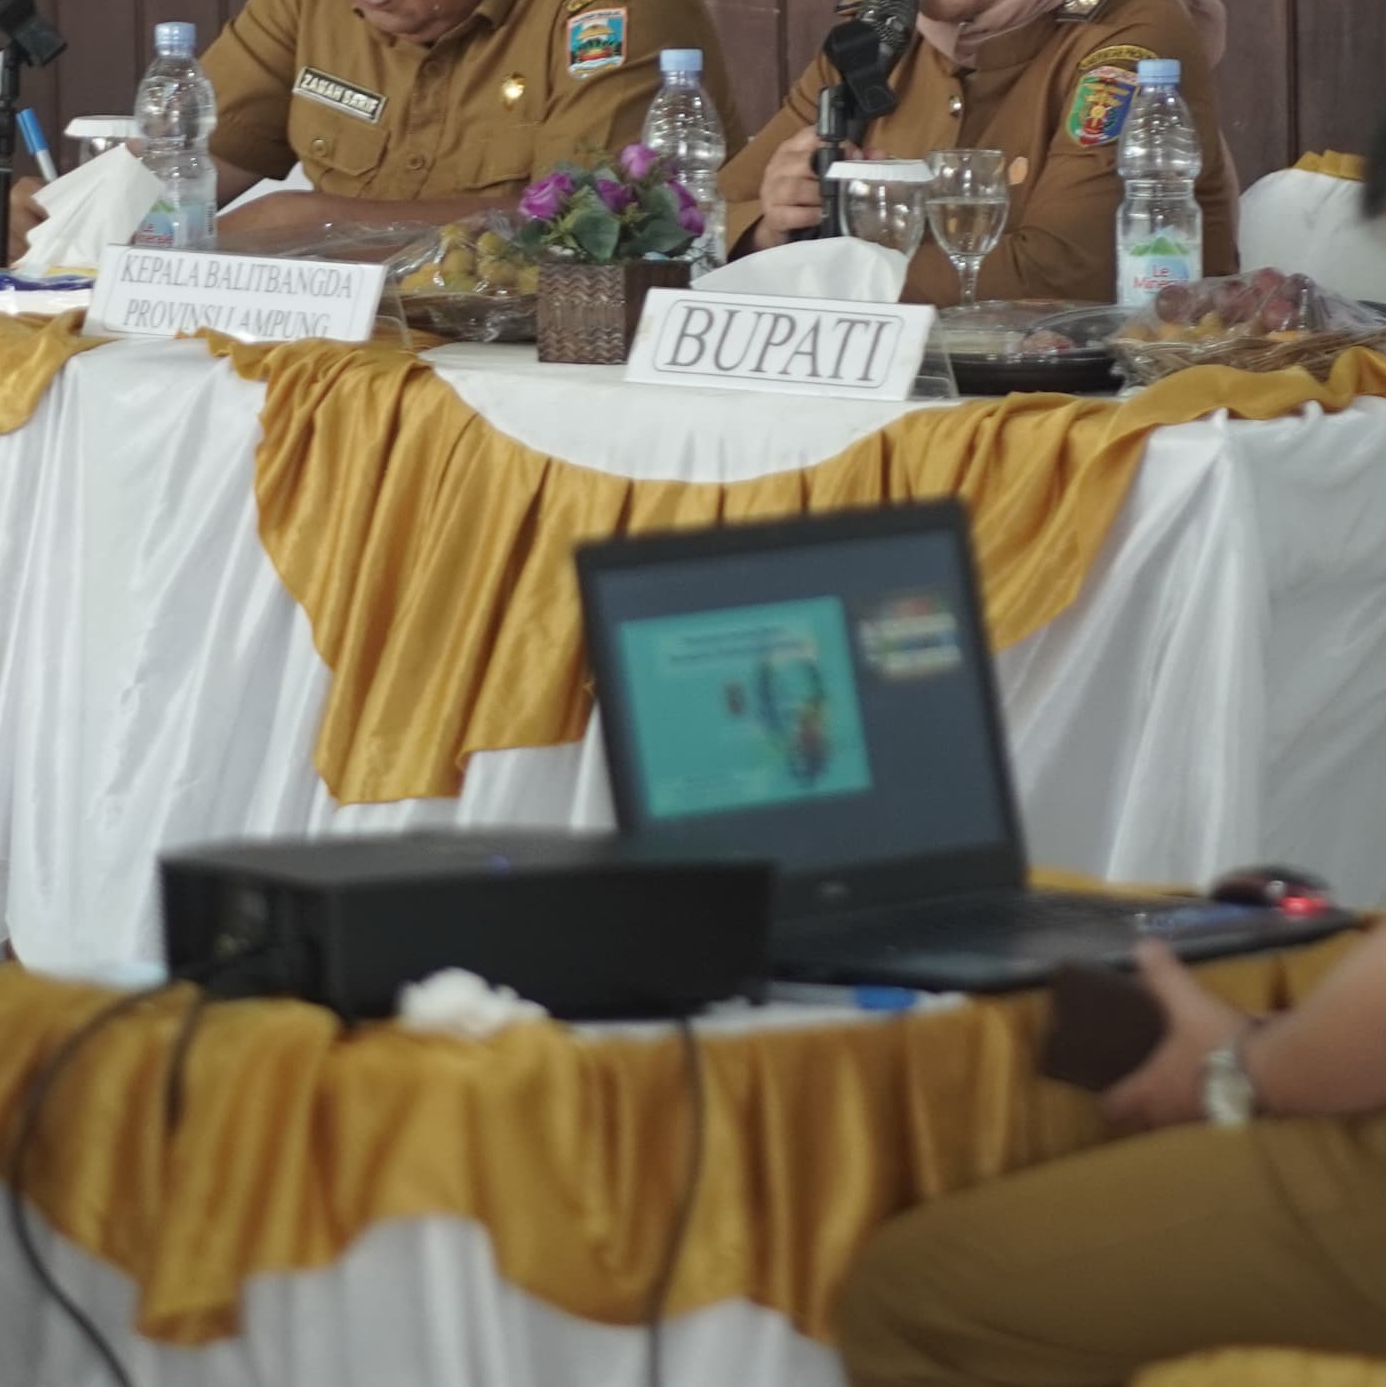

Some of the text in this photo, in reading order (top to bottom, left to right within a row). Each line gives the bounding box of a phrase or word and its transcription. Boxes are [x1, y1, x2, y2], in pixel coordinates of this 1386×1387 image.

[121, 255, 355, 300] KEPALA BALITBANGDA
[664, 304, 894, 382] BUPATI
